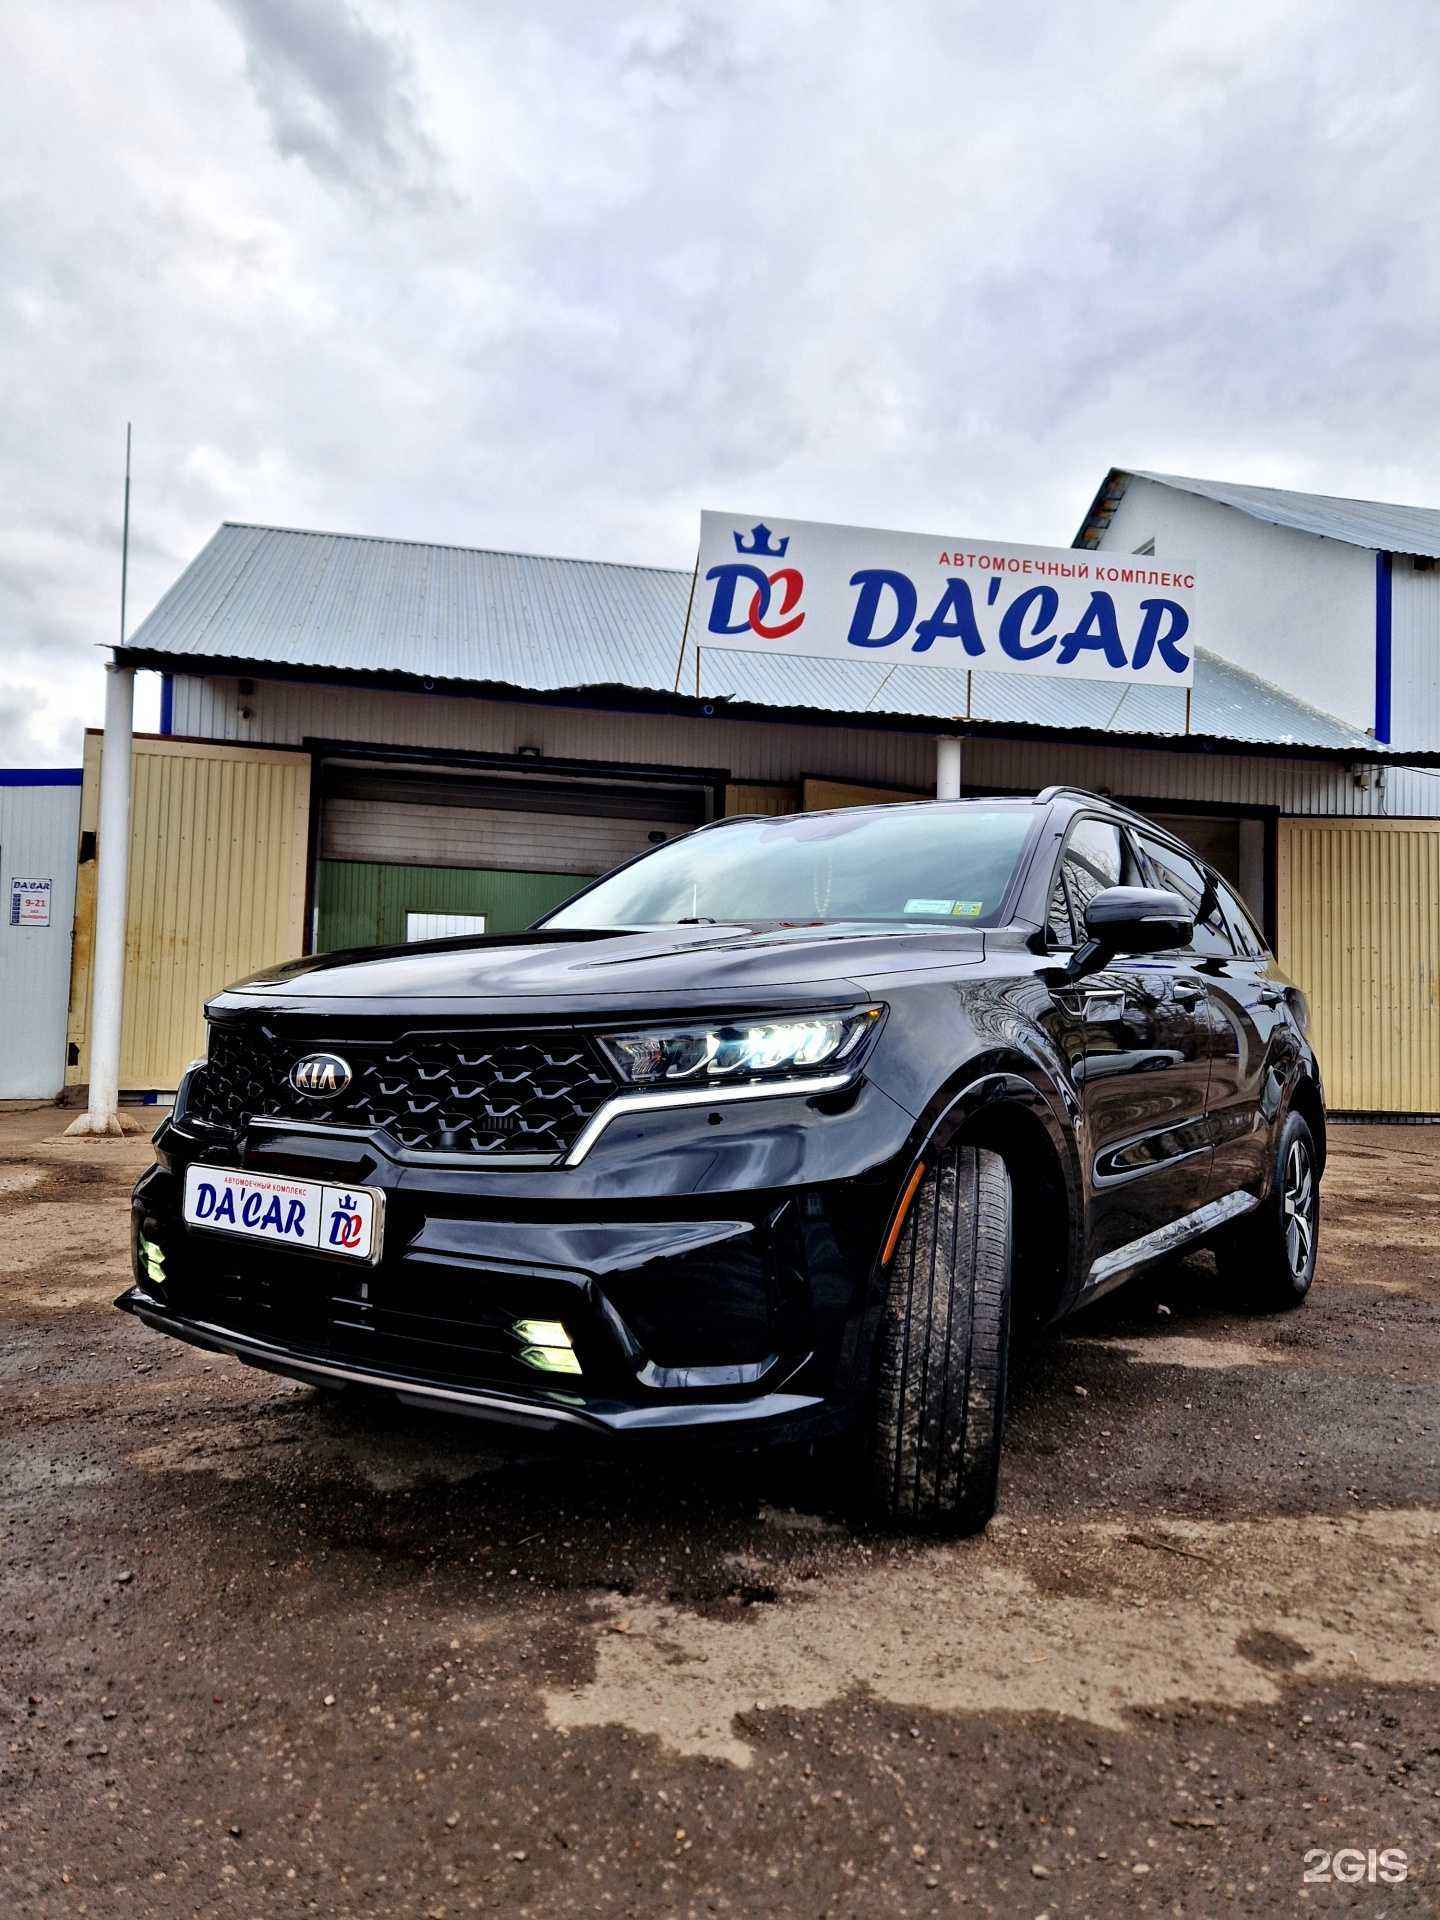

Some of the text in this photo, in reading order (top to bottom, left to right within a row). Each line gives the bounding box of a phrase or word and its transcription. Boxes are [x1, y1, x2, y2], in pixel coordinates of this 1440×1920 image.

[939, 551, 1195, 588] АВТОМОЕЧНЫЙ КОМПЛЕКС
[847, 569, 1190, 673] DA'CAR
[25, 899, 46, 907] 9-21
[296, 1063, 336, 1089] KIA
[224, 1176, 307, 1196] АВТОМОЕЧНЫЙ КОМПЛЕКС
[195, 1183, 306, 1237] DA'CAR
